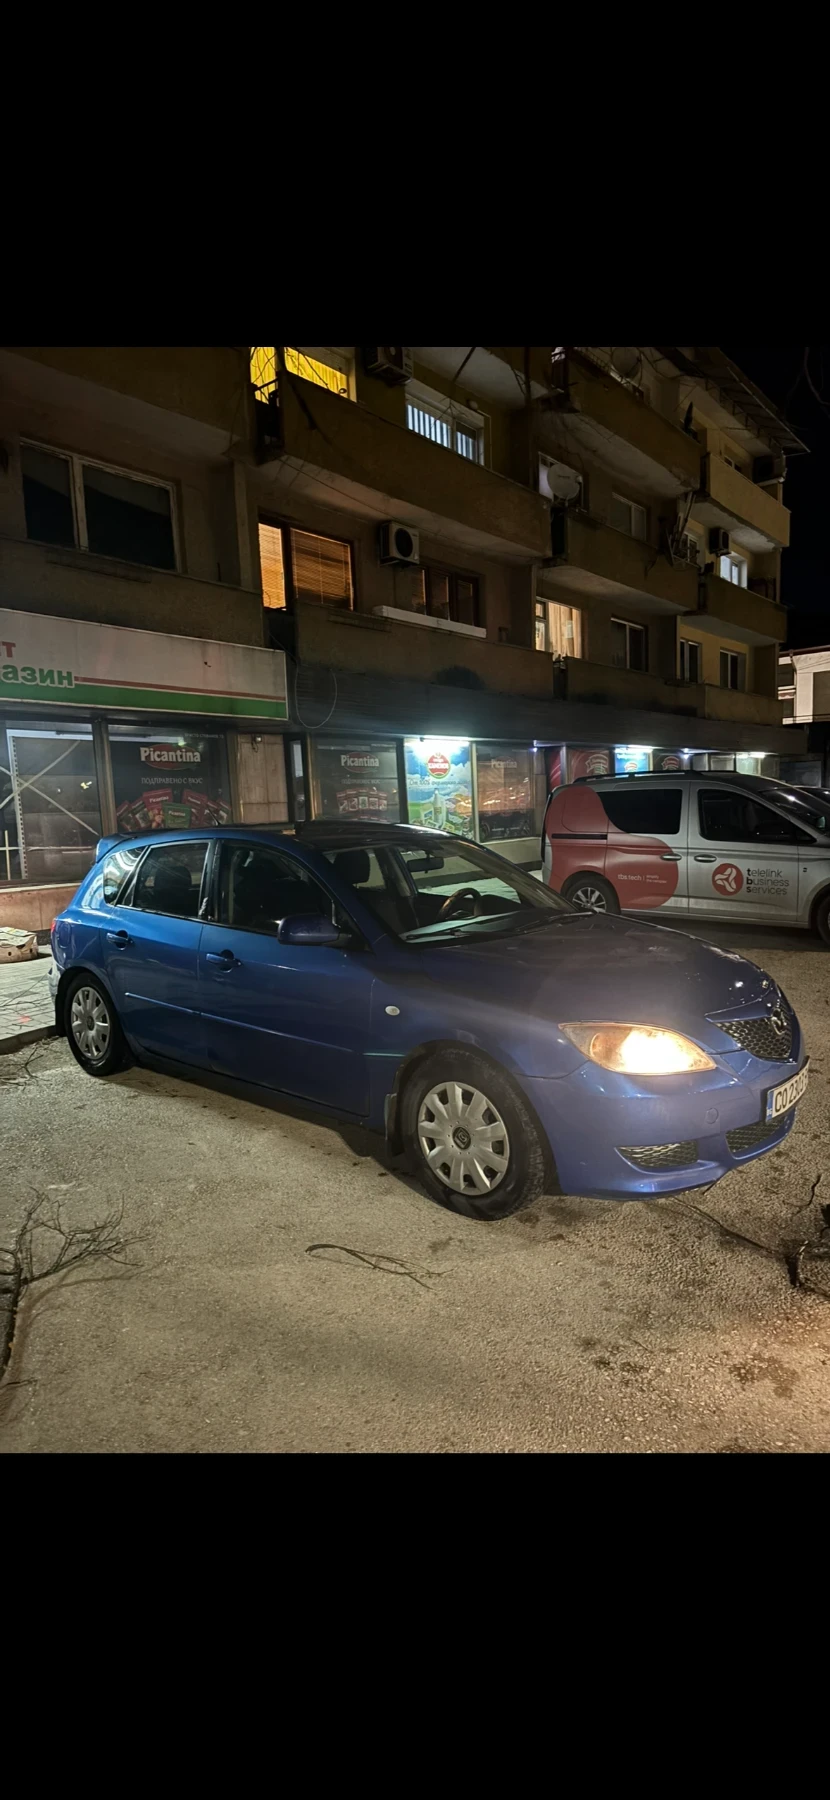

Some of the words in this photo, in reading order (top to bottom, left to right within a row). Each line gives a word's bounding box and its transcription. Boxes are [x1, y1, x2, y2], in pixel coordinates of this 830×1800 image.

[140, 747, 201, 762] Picantina
[341, 754, 380, 767] Picantina
[141, 777, 183, 785] ПОДПРАВЕНО
[746, 868, 783, 878] telelink
[746, 877, 790, 887] business
[746, 886, 788, 895] services
